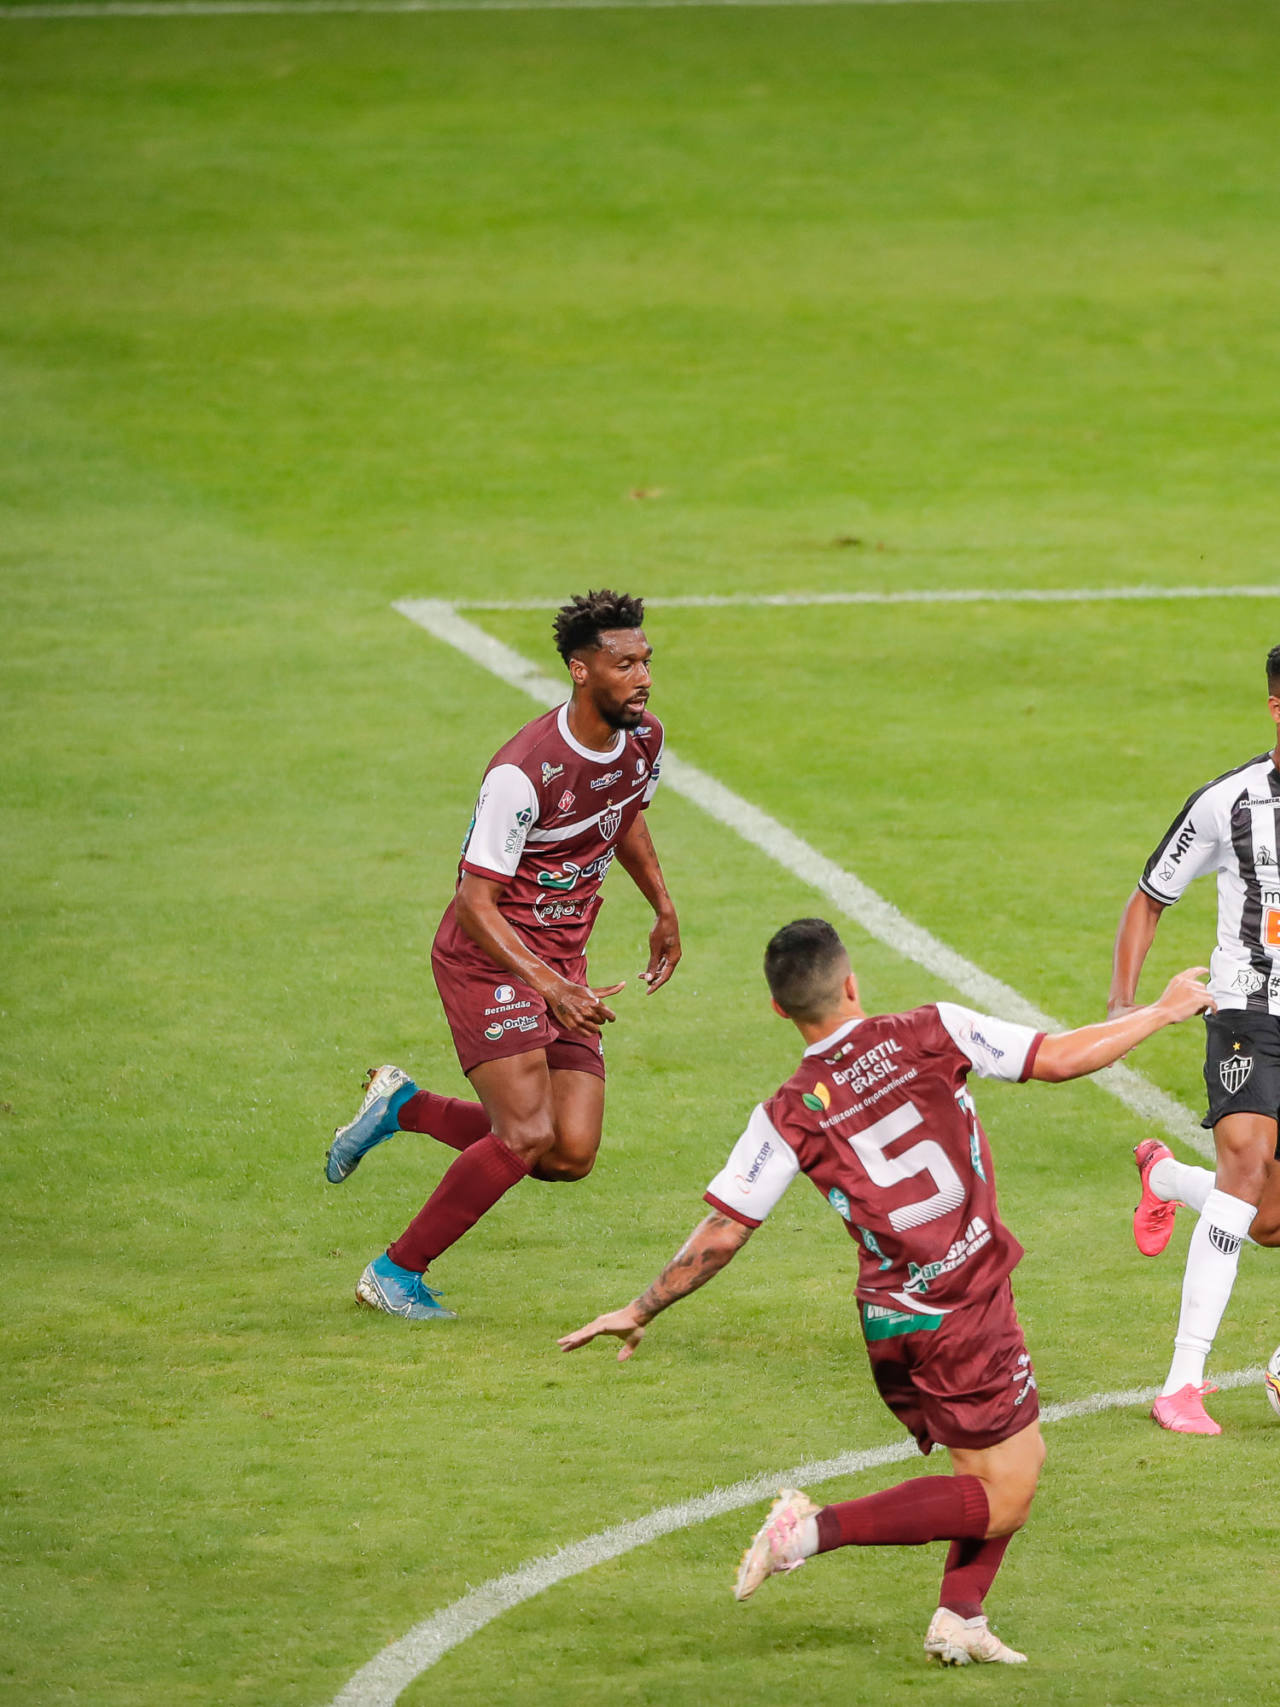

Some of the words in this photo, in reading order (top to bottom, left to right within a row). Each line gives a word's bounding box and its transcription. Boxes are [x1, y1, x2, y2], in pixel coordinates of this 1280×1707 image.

[1169, 819, 1197, 864] MRV
[484, 1000, 531, 1016] Bernardão
[851, 1058, 899, 1095] BRASIL
[1223, 1060, 1248, 1071] CAM
[745, 1141, 771, 1183] UNICERP
[848, 1100, 966, 1233] 5
